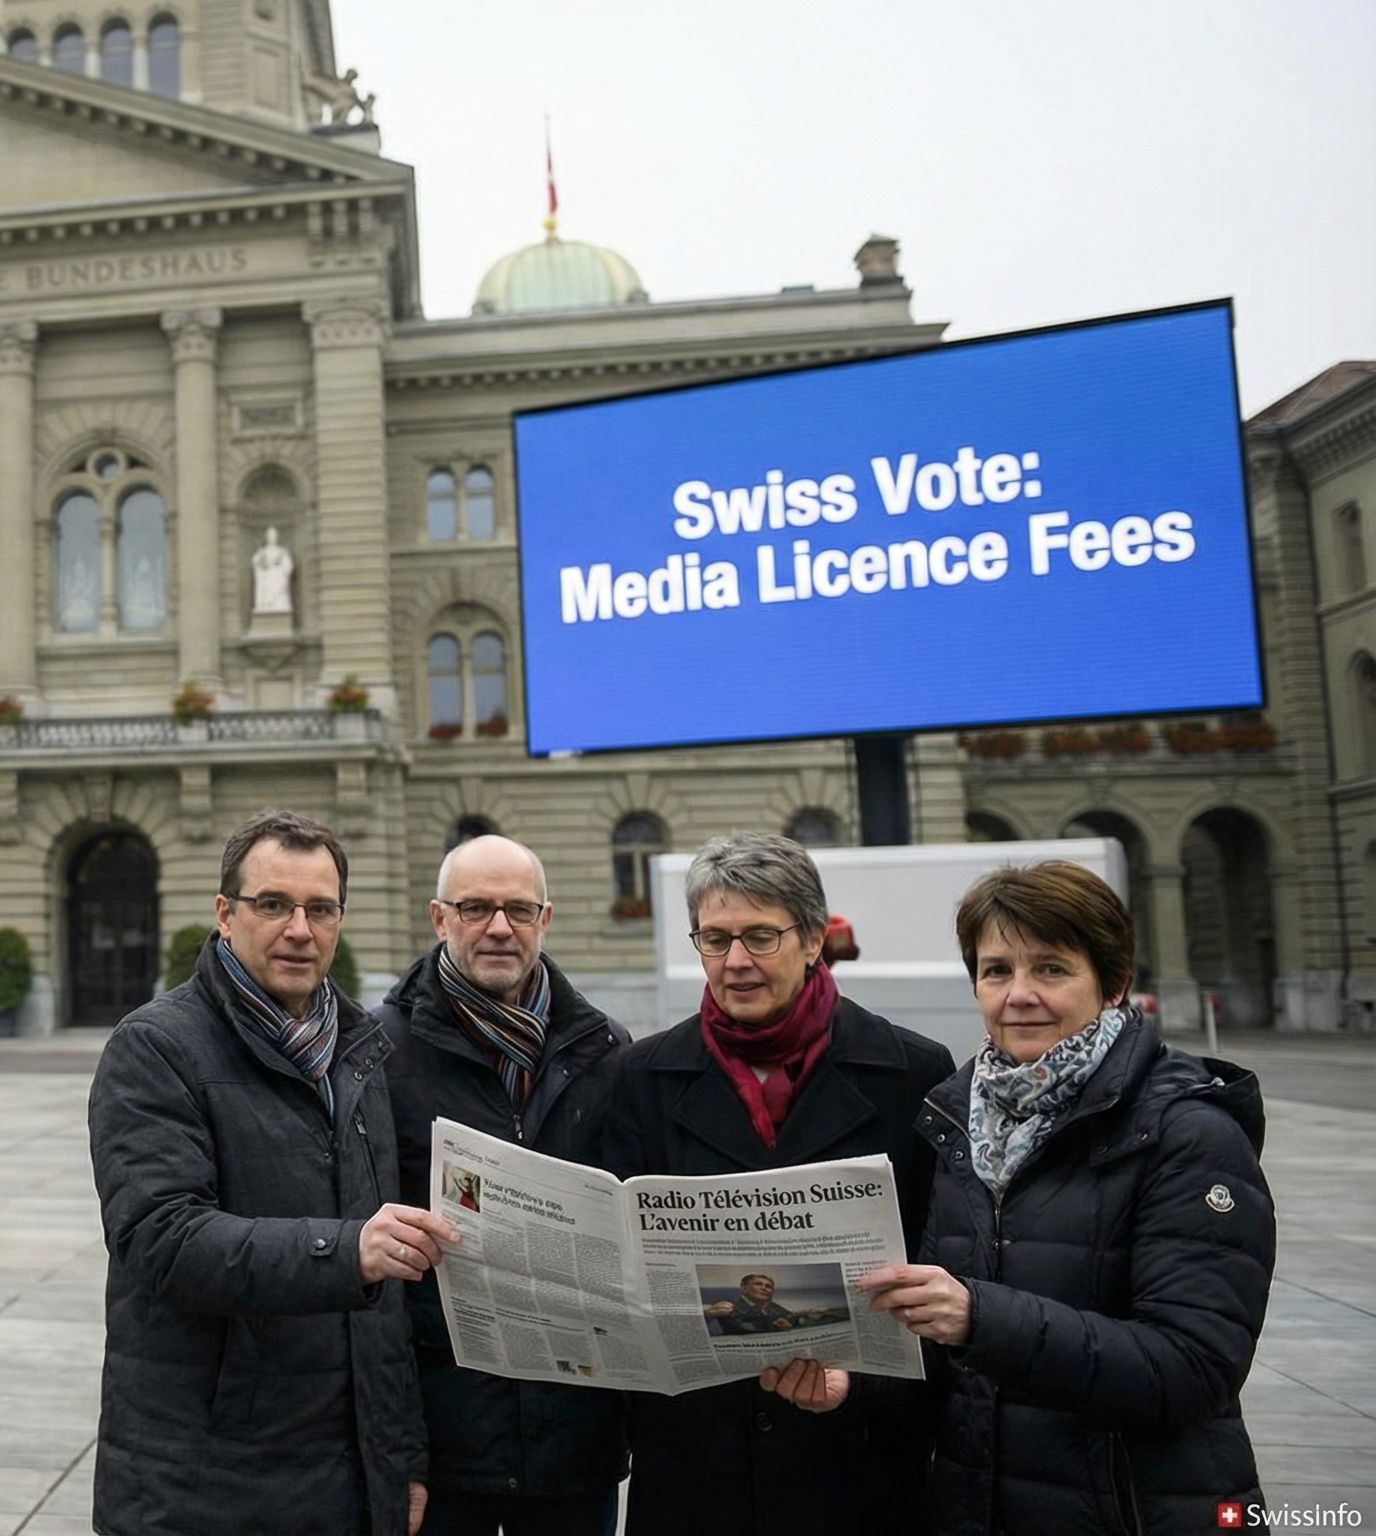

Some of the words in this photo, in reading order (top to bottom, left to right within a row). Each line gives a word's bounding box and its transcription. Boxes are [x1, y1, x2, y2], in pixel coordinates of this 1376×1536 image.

[25, 247, 250, 291] BUNDESHAUS
[673, 469, 858, 540] Swiss
[871, 447, 1042, 515] Vote:
[560, 552, 740, 624] Media
[757, 531, 1009, 603] Licence
[1029, 510, 1196, 575] Fees
[636, 1189, 696, 1210] Radio
[698, 1186, 807, 1210] Télévision
[809, 1181, 883, 1204] Suisse:
[723, 1217, 750, 1232] en
[754, 1210, 815, 1231] débat
